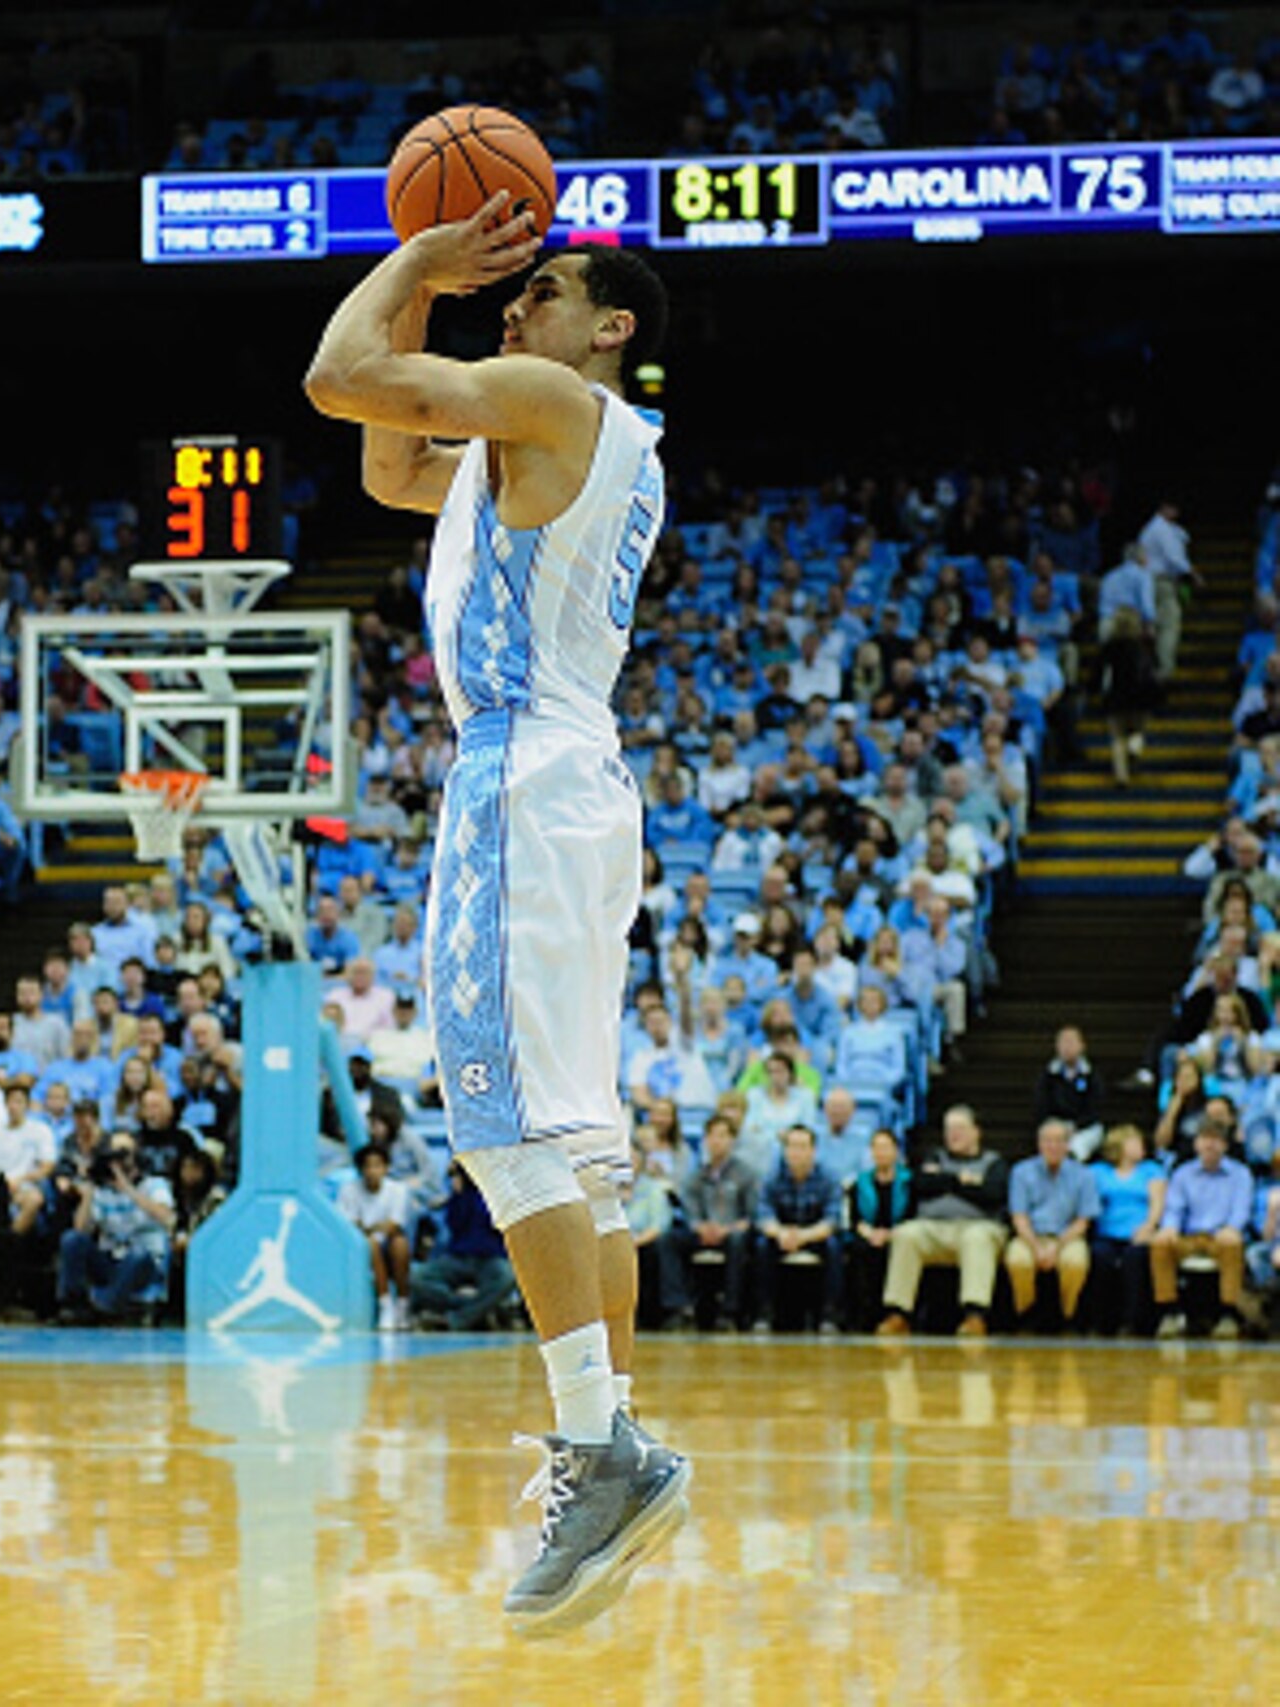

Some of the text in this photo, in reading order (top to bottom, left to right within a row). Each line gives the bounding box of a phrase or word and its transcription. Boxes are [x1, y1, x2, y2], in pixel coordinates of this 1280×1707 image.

[288, 183, 311, 215] 6
[556, 173, 630, 228] 46
[672, 160, 797, 222] 8:11
[832, 156, 1148, 214] CAROLINA 75
[287, 219, 308, 252] 2
[175, 445, 261, 488] 8:11
[167, 487, 251, 556] 31
